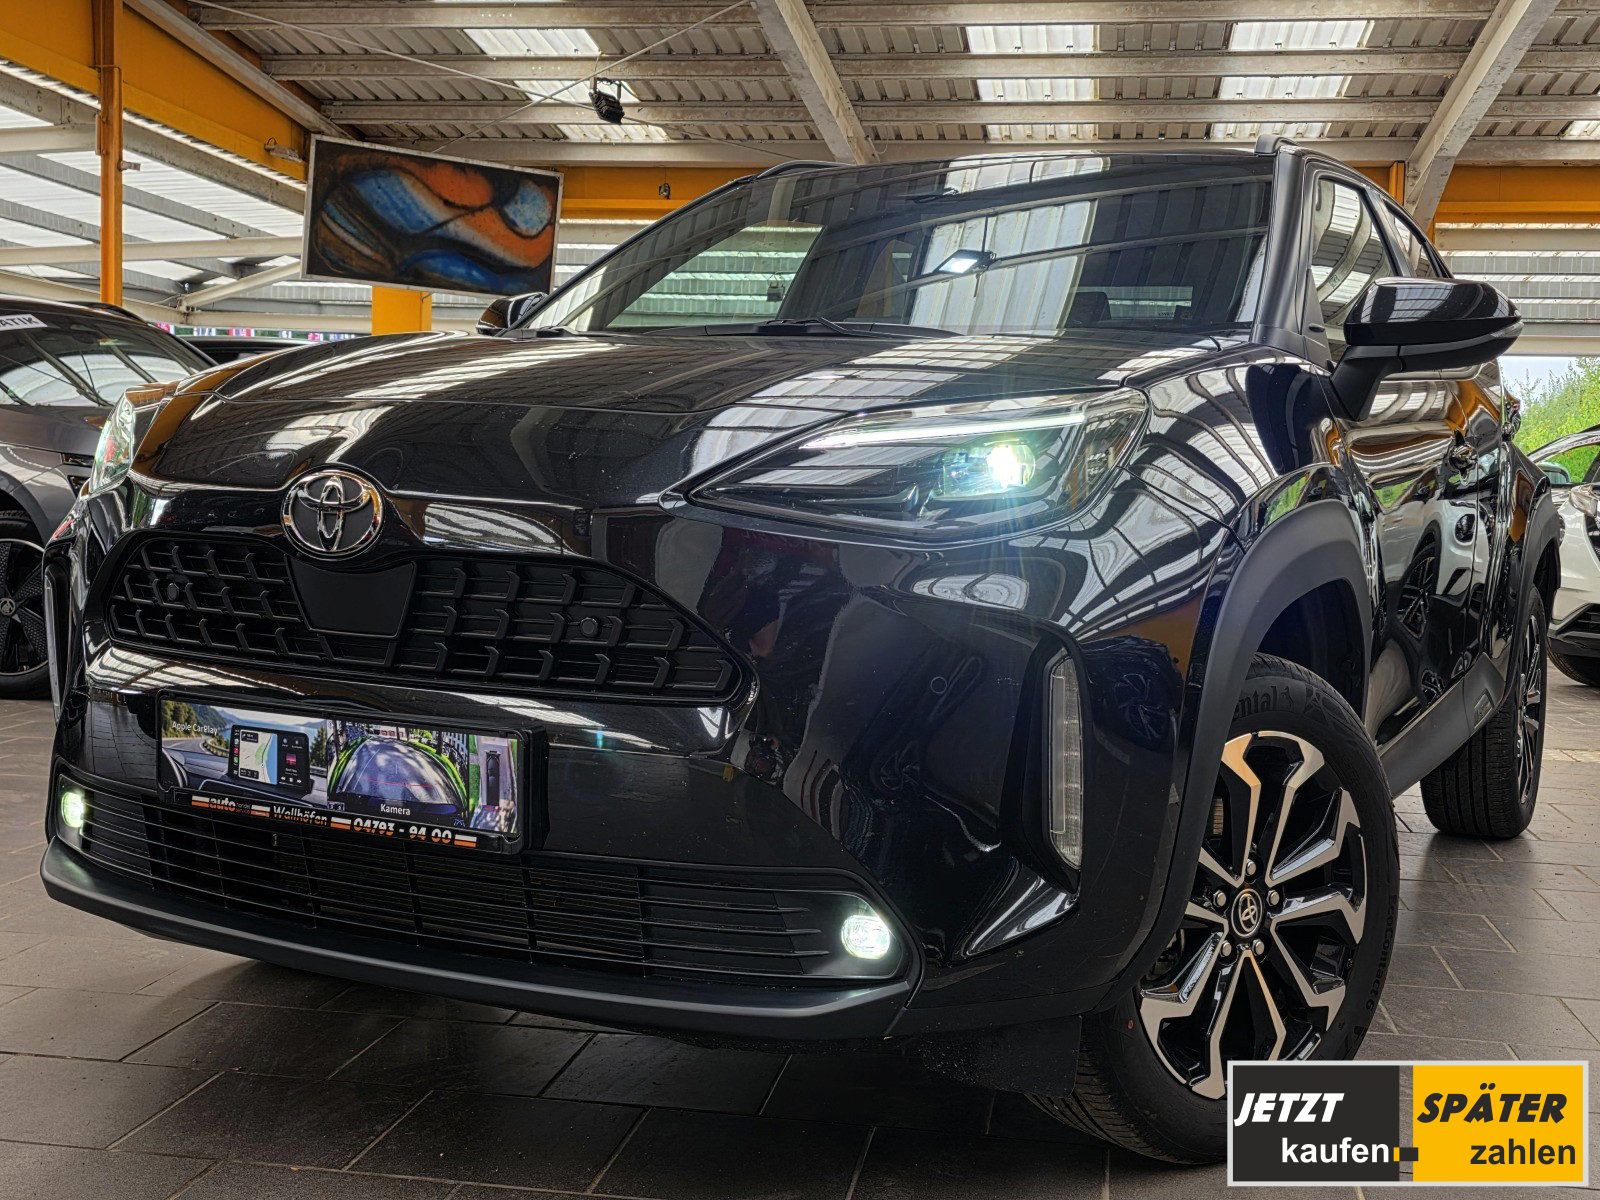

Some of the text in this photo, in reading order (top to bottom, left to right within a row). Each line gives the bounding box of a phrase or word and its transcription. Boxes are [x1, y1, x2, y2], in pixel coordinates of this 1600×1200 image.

[0, 317, 39, 327] ATIK
[172, 721, 218, 736] Apple CarPlay
[380, 804, 411, 816] Kamera
[208, 797, 236, 812] auto
[273, 806, 328, 826] Wallhöfen
[353, 817, 395, 837] 04793
[408, 825, 427, 841] 94
[431, 828, 452, 844] 00
